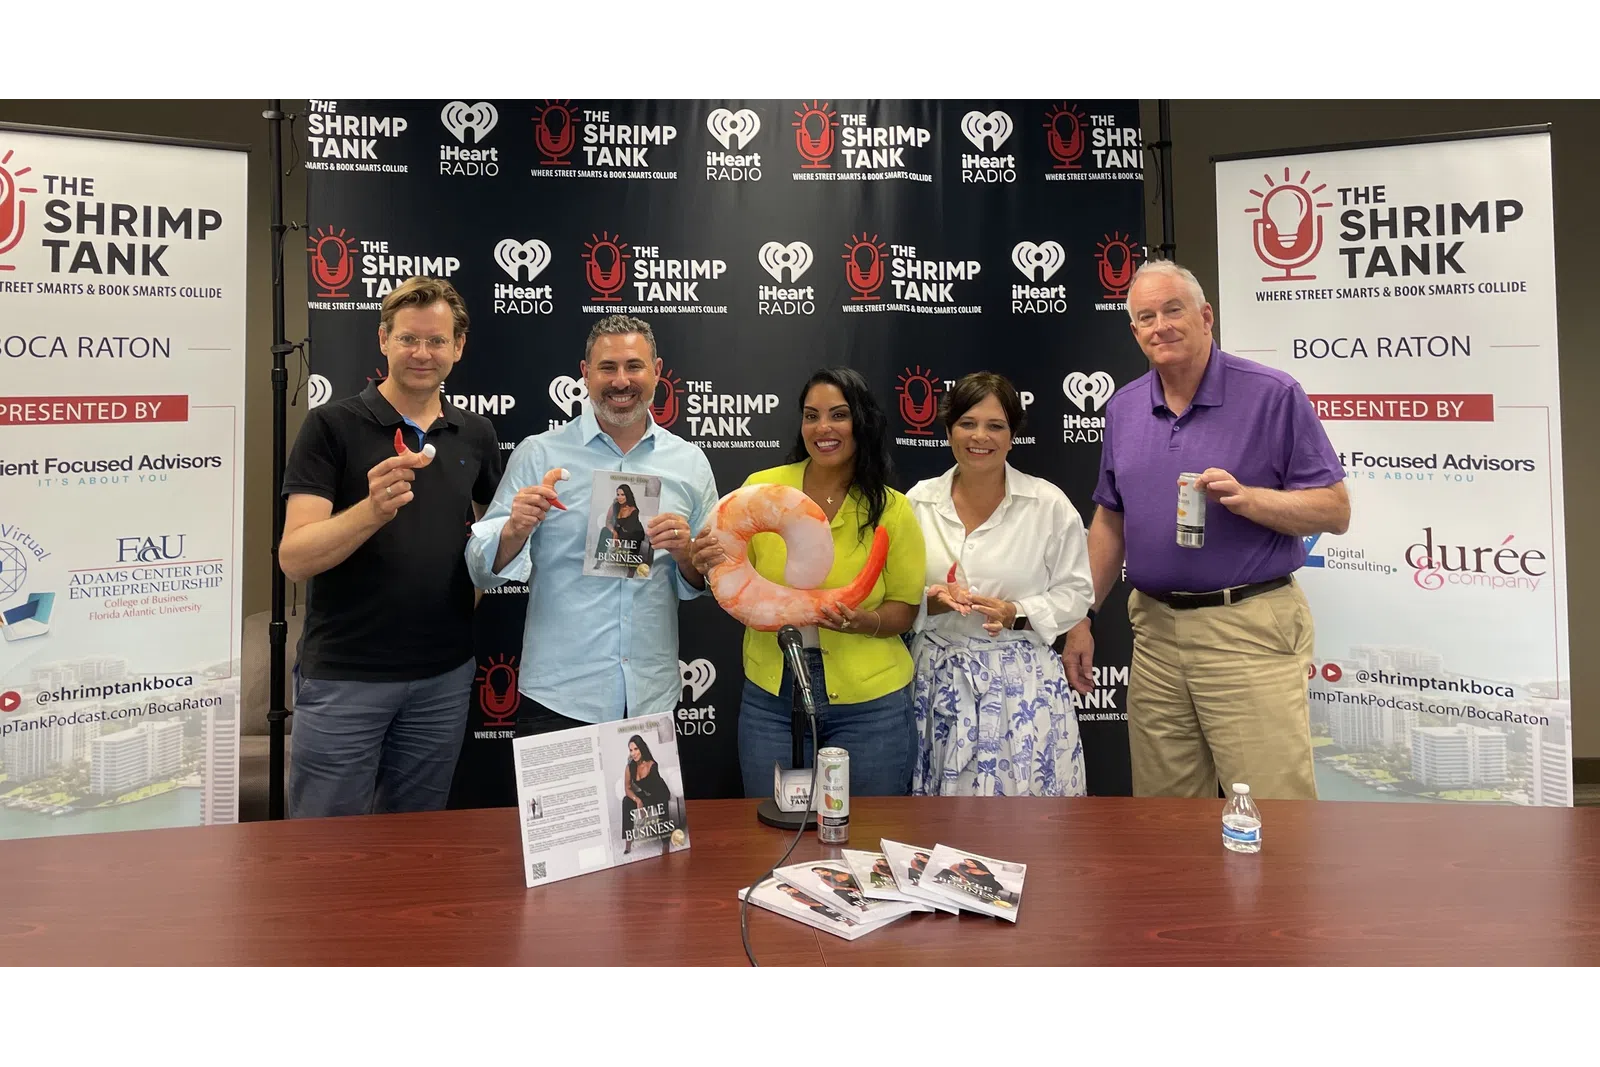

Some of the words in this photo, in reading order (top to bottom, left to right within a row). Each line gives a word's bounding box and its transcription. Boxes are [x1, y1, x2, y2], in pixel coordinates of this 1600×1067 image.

[309, 99, 337, 113] THE
[583, 110, 610, 123] THE
[841, 114, 867, 126] THE
[1090, 115, 1115, 126] THE
[308, 113, 408, 138] SHRIMP
[583, 123, 677, 146] SHRIMP
[841, 125, 931, 148] SHRIMP
[307, 137, 378, 160] TANK
[440, 144, 498, 161] iHeart
[582, 146, 649, 168] TANK
[706, 151, 761, 167] iHeart
[841, 148, 905, 169] TANK
[962, 154, 1015, 169] iHeart
[336, 163, 354, 171] BOOK
[355, 164, 382, 172] SMARTS
[382, 164, 408, 173] COLLIDE
[440, 162, 499, 177] RADIO
[530, 169, 554, 178] WHERE
[554, 169, 576, 178] STREET
[577, 170, 602, 178] SMARTS
[609, 170, 626, 179] BOOK
[627, 171, 652, 179] SMARTS
[652, 172, 678, 180] COLLIDE
[706, 167, 762, 181] RADIO
[792, 172, 814, 180] WHERE
[815, 172, 836, 180] STREET
[836, 172, 861, 180] SMARTS
[867, 172, 884, 180] BOOK
[884, 171, 908, 180] SMARTS
[908, 172, 932, 182] COLLIDE
[962, 169, 1016, 183] RADIO
[43, 174, 94, 197] THE
[1045, 173, 1066, 181] WHERE
[1337, 184, 1386, 206] THE
[43, 199, 223, 240] SHRIMP
[1339, 199, 1524, 242] SHRIMP
[360, 240, 389, 254] THE
[632, 246, 659, 258] THE
[890, 244, 916, 258] THE
[42, 239, 170, 277] TANK
[362, 254, 460, 277] SHRIMP
[1338, 241, 1466, 279] TANK
[633, 259, 727, 280] SHRIMP
[891, 258, 981, 281] SHRIMP
[36, 282, 84, 294] SMARTS
[86, 284, 96, 295] &
[98, 284, 130, 296] BOOK
[132, 286, 177, 297] SMARTS
[180, 286, 222, 299] COLLIDE
[494, 283, 552, 300] iHeart
[633, 281, 700, 302] TANK
[758, 284, 814, 300] iHeart
[890, 280, 954, 302] TANK
[1012, 284, 1066, 300] iHeart
[1256, 290, 1293, 302] WHERE
[1295, 288, 1333, 300] STREET
[1336, 286, 1380, 299] SMARTS
[1382, 286, 1392, 297] &
[1394, 285, 1426, 297] BOOK
[1428, 283, 1475, 296] SMARTS
[1478, 281, 1527, 294] COLLIDE
[308, 302, 332, 310] WHERE
[332, 302, 356, 310] STREET
[356, 302, 382, 311] SMARTS
[494, 300, 554, 315] RADIO
[582, 305, 605, 314] WHERE
[606, 306, 628, 314] STREET
[628, 306, 654, 314] SMARTS
[660, 306, 677, 314] BOOK
[678, 306, 702, 314] SMARTS
[702, 306, 728, 314] COLLIDE
[758, 300, 816, 316] RADIO
[842, 304, 864, 313] WHERE
[864, 304, 886, 312] STREET
[886, 303, 910, 312] SMARTS
[916, 304, 933, 314] BOOK
[934, 305, 958, 314] SMARTS
[958, 305, 982, 314] COLLIDE
[1012, 300, 1067, 314] RADIO
[0, 336, 68, 358] OCA
[78, 336, 170, 358] RATON
[1293, 338, 1368, 359] BOCA
[1378, 335, 1471, 358] RATON
[686, 380, 712, 392] THE
[135, 402, 162, 419] BY
[445, 394, 516, 415] RIMP
[686, 394, 780, 414] SHRIMP
[1437, 400, 1464, 418] BY
[686, 416, 752, 436] TANK
[896, 438, 917, 446] WHERE
[918, 438, 939, 447] STREET
[44, 456, 133, 475] Focused
[138, 453, 222, 471] Advisors
[1352, 452, 1437, 469] Focused
[1442, 454, 1536, 472] Advisors
[38, 478, 69, 487] IT'S
[78, 475, 130, 486] ABOUT
[138, 473, 168, 482] YOU
[1347, 471, 1375, 480] IT'S
[1384, 472, 1434, 481] ABOUT
[1444, 473, 1474, 482] YOU
[2, 524, 52, 562] Virtual
[116, 534, 186, 562] FAU
[605, 539, 637, 550] STYLE
[1404, 526, 1546, 577] durée
[598, 552, 643, 563] BUSINESS
[1327, 548, 1365, 560] Digital
[69, 571, 128, 586] ADAMS
[132, 566, 192, 581] CENTER
[196, 564, 224, 576] FOR
[1414, 555, 1444, 590] &
[1448, 572, 1540, 592] company
[69, 576, 223, 600] ENTREPRENEURSHIP
[104, 598, 138, 609] College
[140, 596, 150, 605] of
[152, 594, 188, 604] Business
[89, 610, 120, 621] Florida
[122, 608, 156, 618] Atlantic
[160, 604, 202, 615] University
[36, 676, 194, 706] @shrimptankboca
[1356, 669, 1514, 698] @shrimptankboca
[0, 696, 222, 737] pTankPodcast.com/BocaRaton
[1079, 713, 1096, 721] BOOK
[1096, 712, 1119, 721] SMARTS
[630, 803, 665, 821] STYLE
[625, 820, 675, 841] BUSINESS
